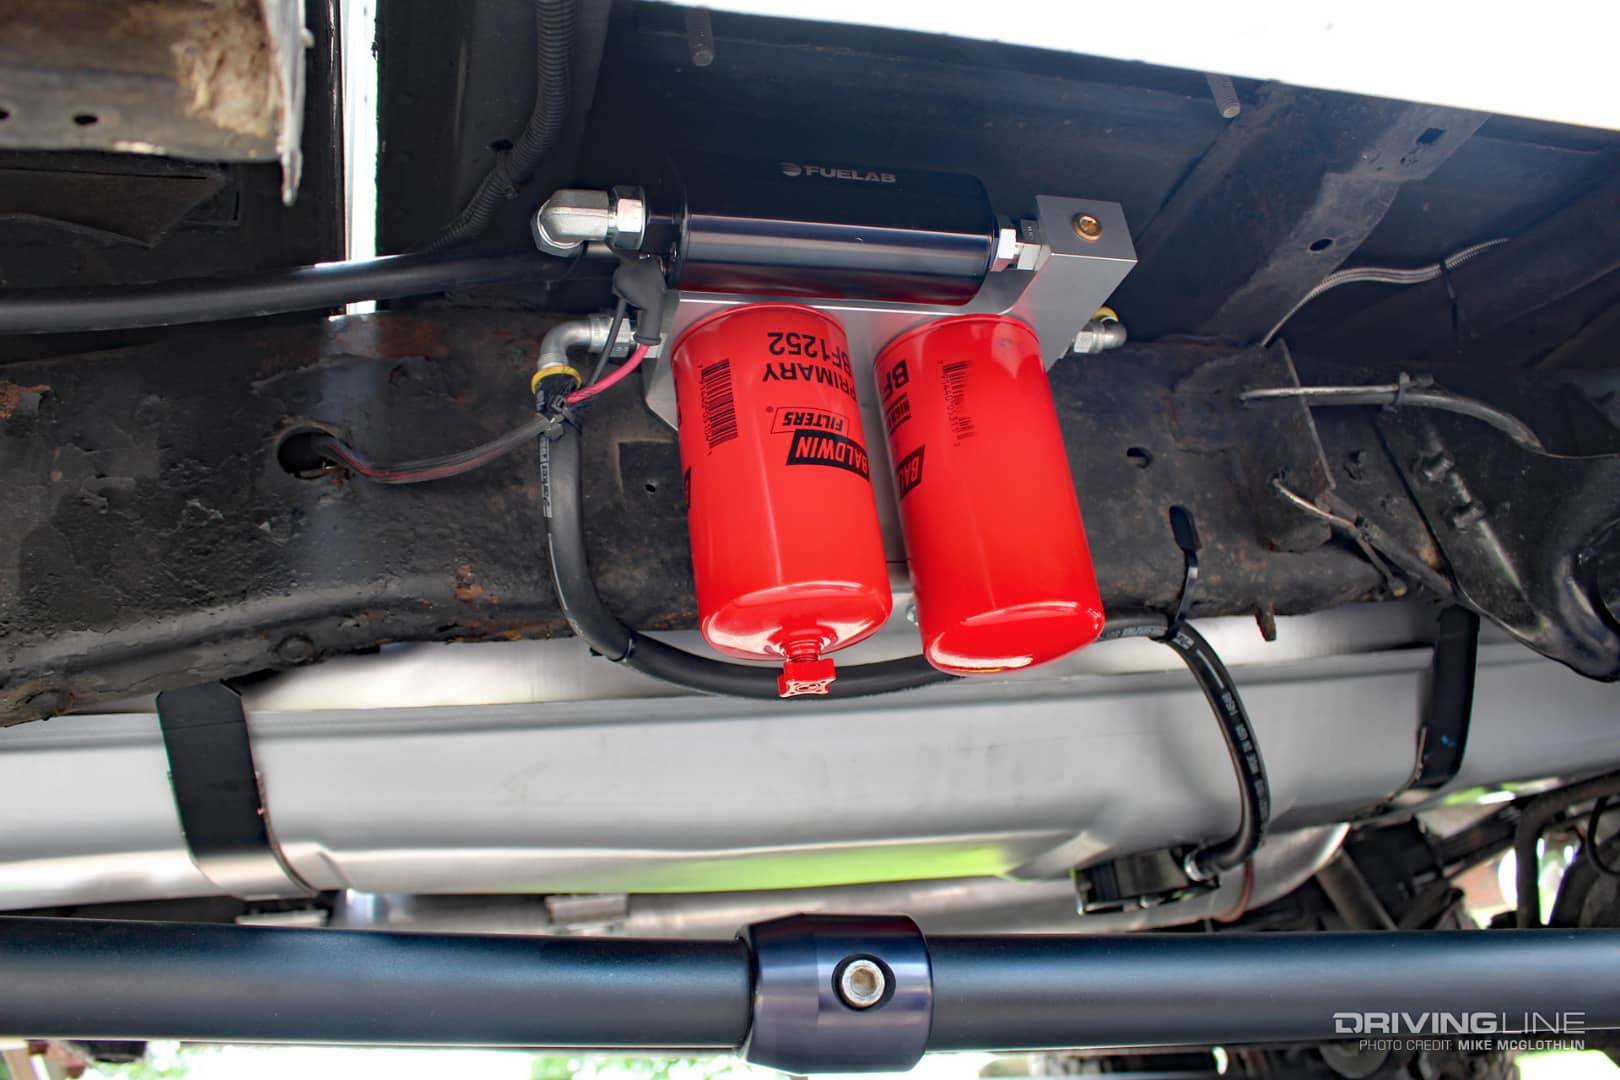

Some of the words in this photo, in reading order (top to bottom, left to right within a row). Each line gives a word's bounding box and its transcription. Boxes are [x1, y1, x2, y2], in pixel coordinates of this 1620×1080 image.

[803, 165, 897, 184] FUELAB
[767, 332, 851, 375] BF1252
[762, 362, 857, 401] PRIMARY
[783, 412, 844, 432] FILTERS
[794, 435, 869, 474] BALDWIN
